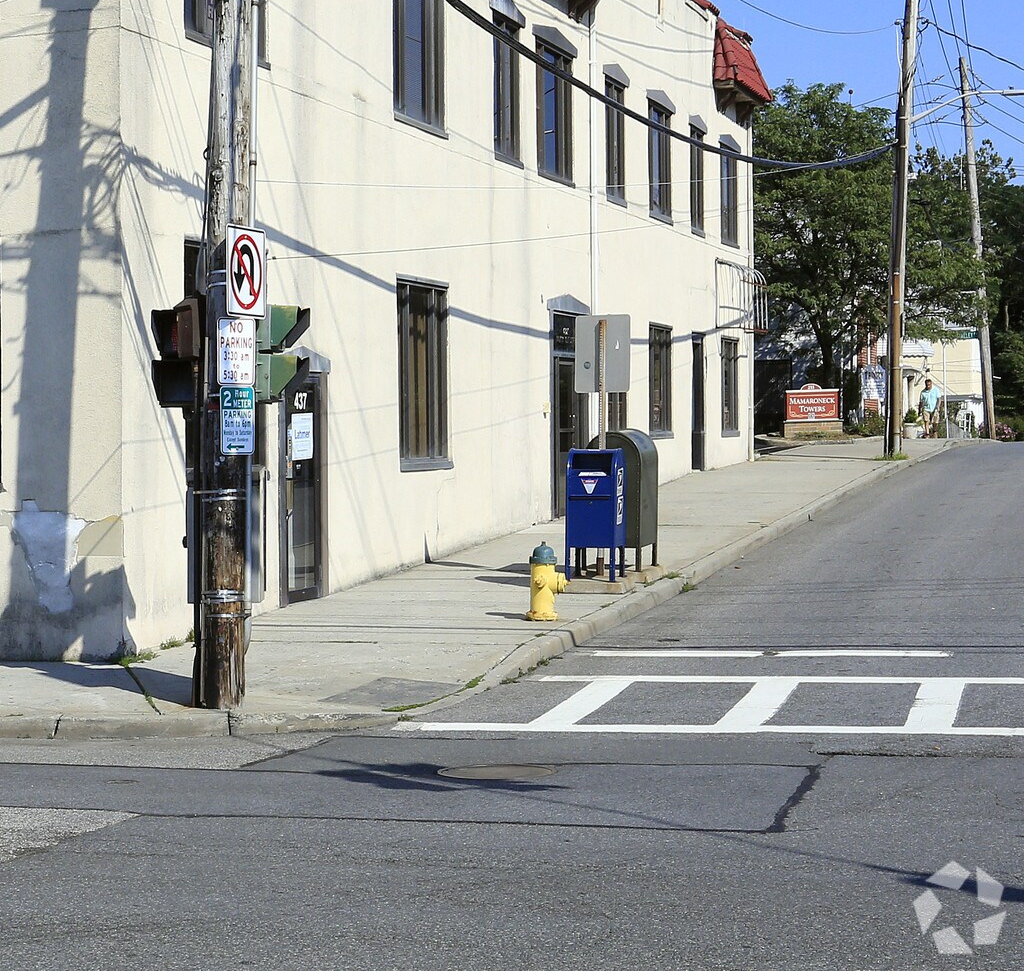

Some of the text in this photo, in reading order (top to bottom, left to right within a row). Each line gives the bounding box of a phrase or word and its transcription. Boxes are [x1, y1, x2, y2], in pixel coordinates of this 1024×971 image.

[229, 321, 244, 334] NO
[220, 336, 253, 349] PARKING
[223, 390, 232, 407] 2
[232, 399, 252, 409] METER
[293, 392, 308, 410] 437
[789, 397, 836, 405] MAMARONECK
[223, 410, 252, 419] PARKING
[798, 405, 826, 413] TOWERS
